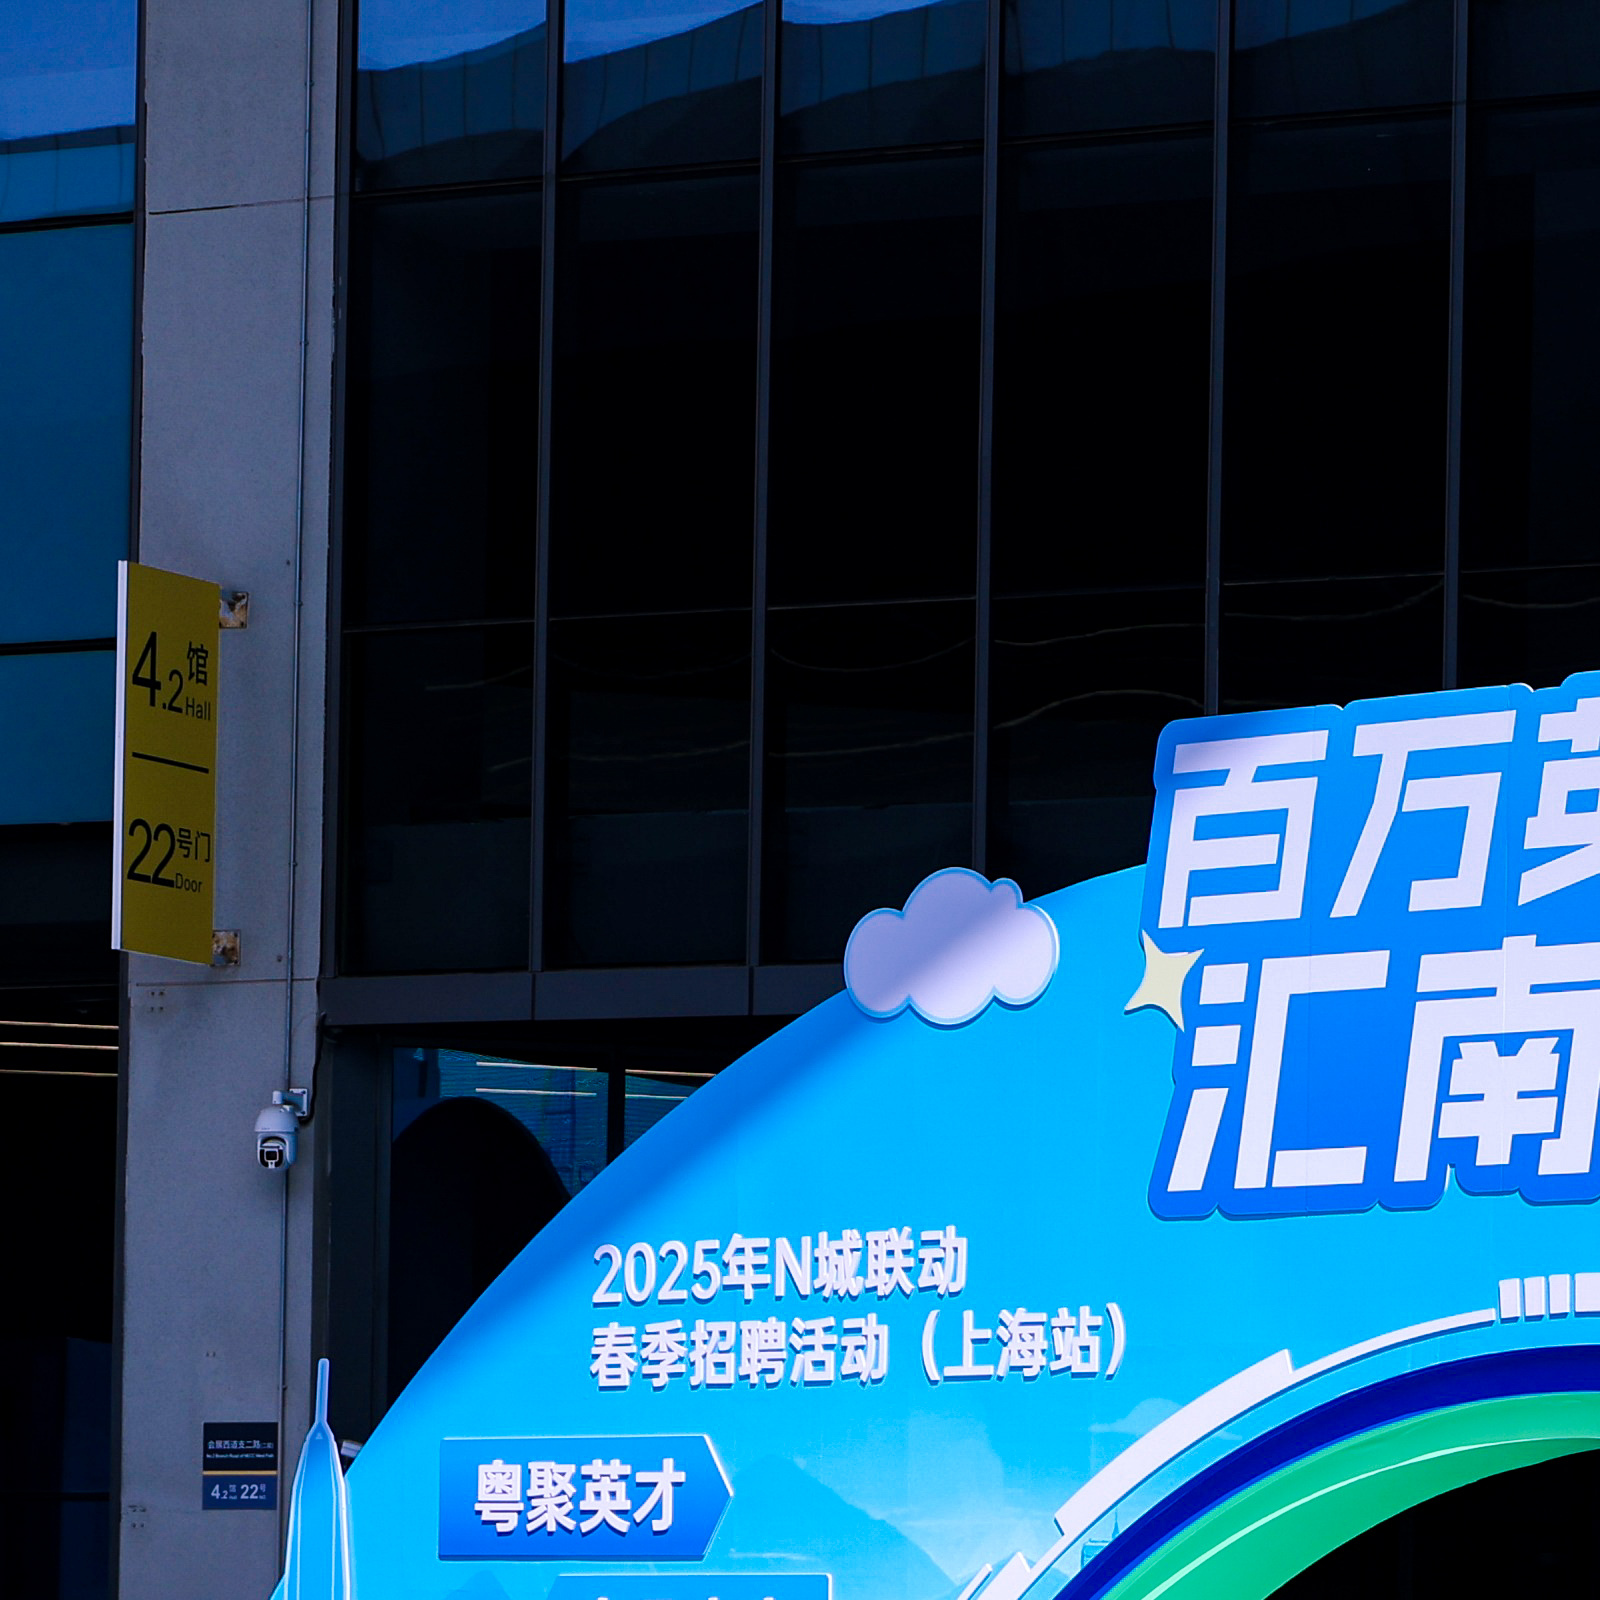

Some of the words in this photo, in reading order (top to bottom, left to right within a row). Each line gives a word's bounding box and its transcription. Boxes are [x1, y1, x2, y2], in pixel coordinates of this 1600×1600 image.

[132, 631, 184, 714] 4.2
[186, 641, 209, 686] 馆
[185, 697, 211, 721] Hall
[127, 818, 176, 888] 22
[176, 827, 211, 863] 号门
[175, 872, 203, 893] Door
[591, 1225, 969, 1305] 2025年N城联动
[589, 1302, 1127, 1390] 春季招聘活动（上海站）
[240, 1484, 259, 1499] 22
[473, 1458, 687, 1534] 粤聚英才
